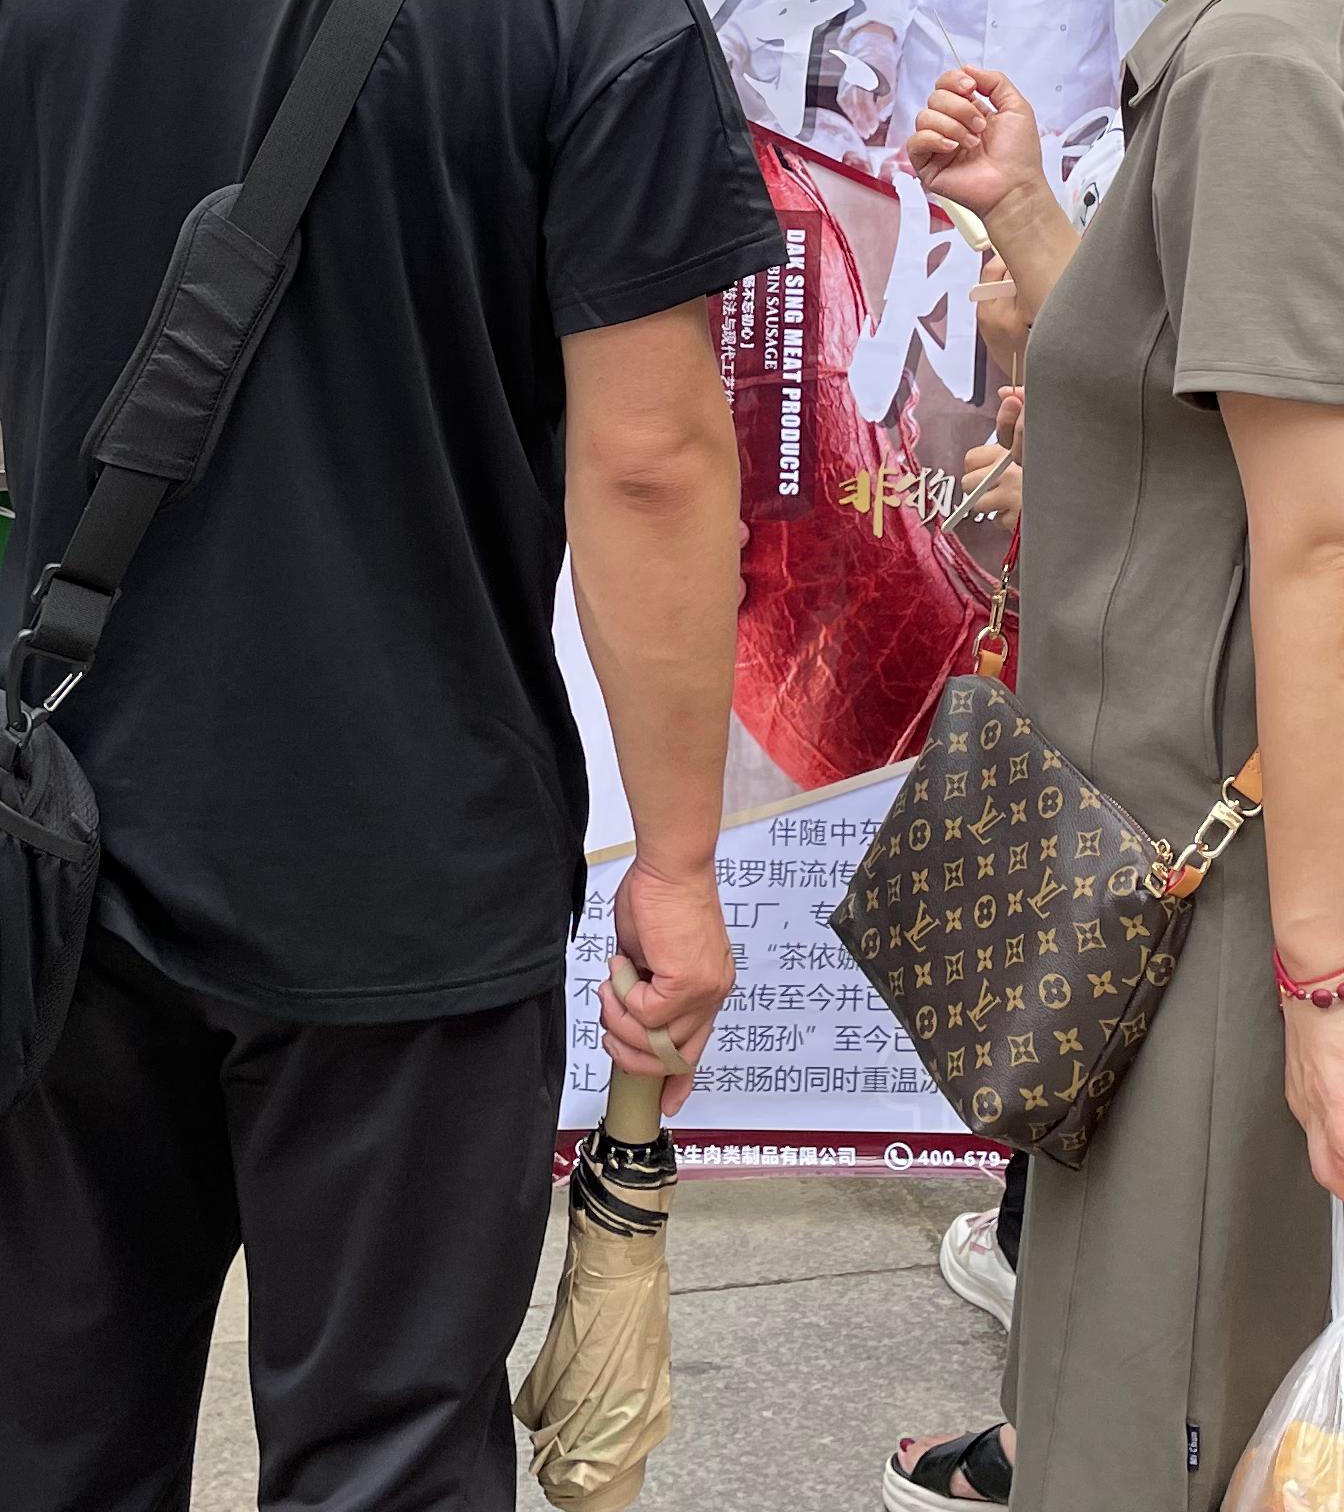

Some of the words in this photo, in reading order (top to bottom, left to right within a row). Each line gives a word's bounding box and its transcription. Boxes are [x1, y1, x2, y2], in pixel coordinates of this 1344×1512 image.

[786, 229, 806, 271] DAK
[766, 265, 781, 294] BIN
[783, 274, 805, 325] SING
[763, 296, 779, 371] SAUSAGE
[782, 329, 804, 384] MEAT
[779, 387, 802, 496] PRODUCTS
[917, 1149, 1011, 1167] 400-679-
